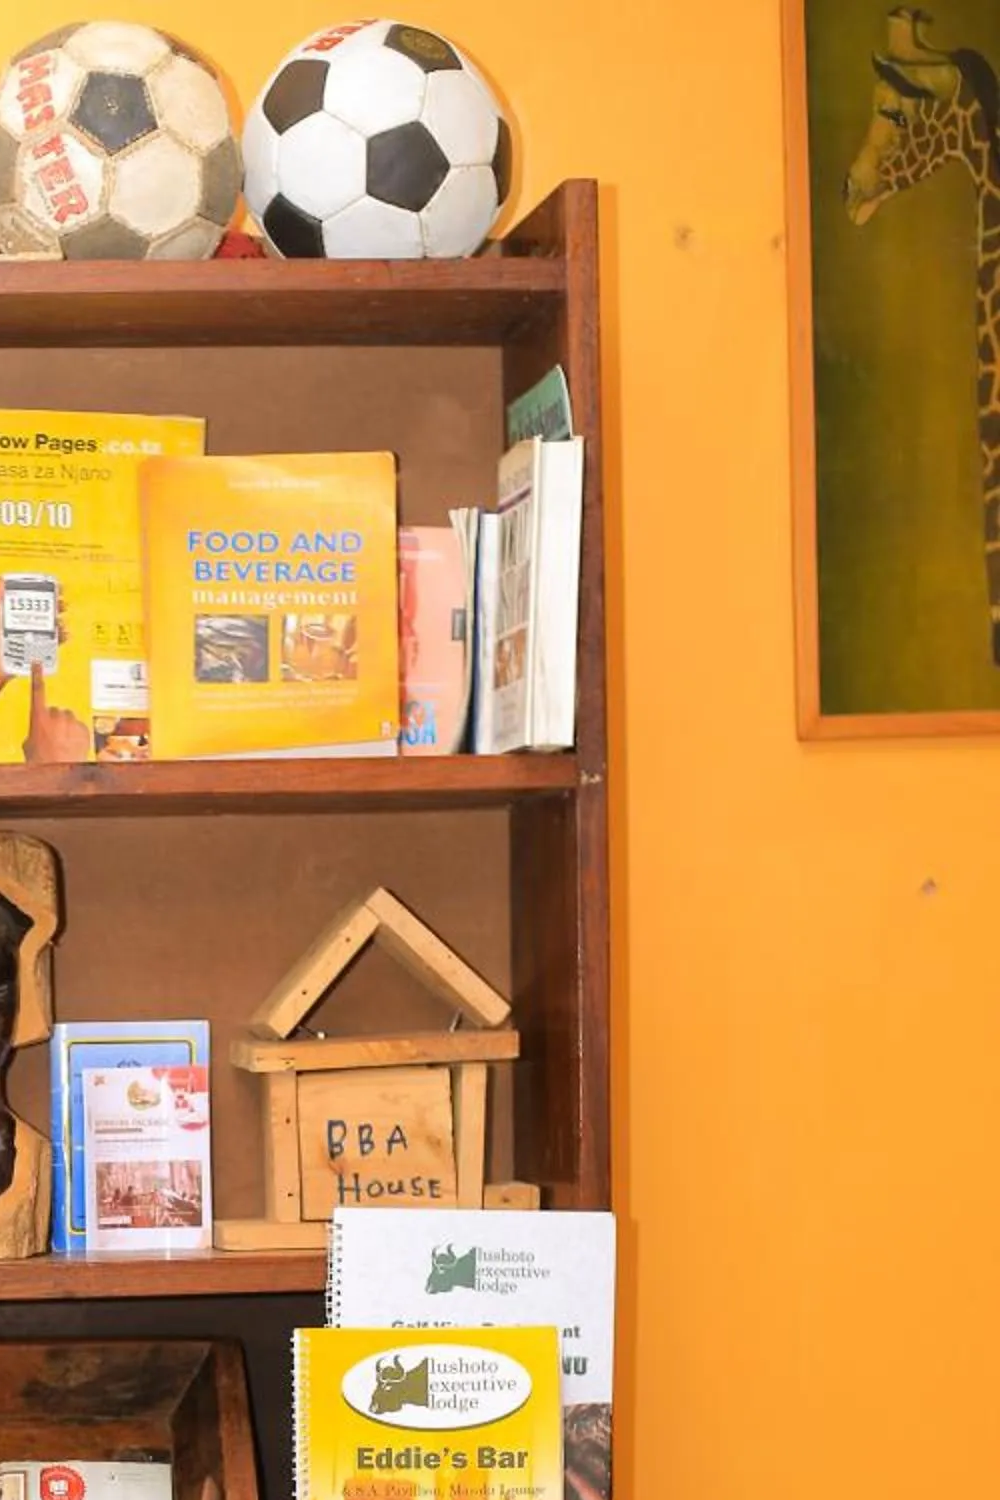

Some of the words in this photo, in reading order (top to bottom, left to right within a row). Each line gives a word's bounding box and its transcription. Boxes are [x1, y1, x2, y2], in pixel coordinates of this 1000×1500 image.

[17, 54, 89, 224] MASTER
[35, 434, 98, 453] Pages
[34, 466, 55, 479] za
[61, 464, 112, 484] Njano
[188, 531, 280, 553] FOOD
[290, 531, 362, 553] AND
[195, 560, 356, 581] BEVERAGE
[193, 589, 358, 609] management
[477, 1247, 535, 1262] lushoto
[477, 1264, 551, 1279] executive
[476, 1279, 518, 1296] lodge
[430, 1358, 498, 1374] lushoto
[429, 1377, 517, 1392] executive
[430, 1394, 479, 1413] lodge
[357, 1447, 468, 1470] Eddie's
[477, 1446, 529, 1469] Bar
